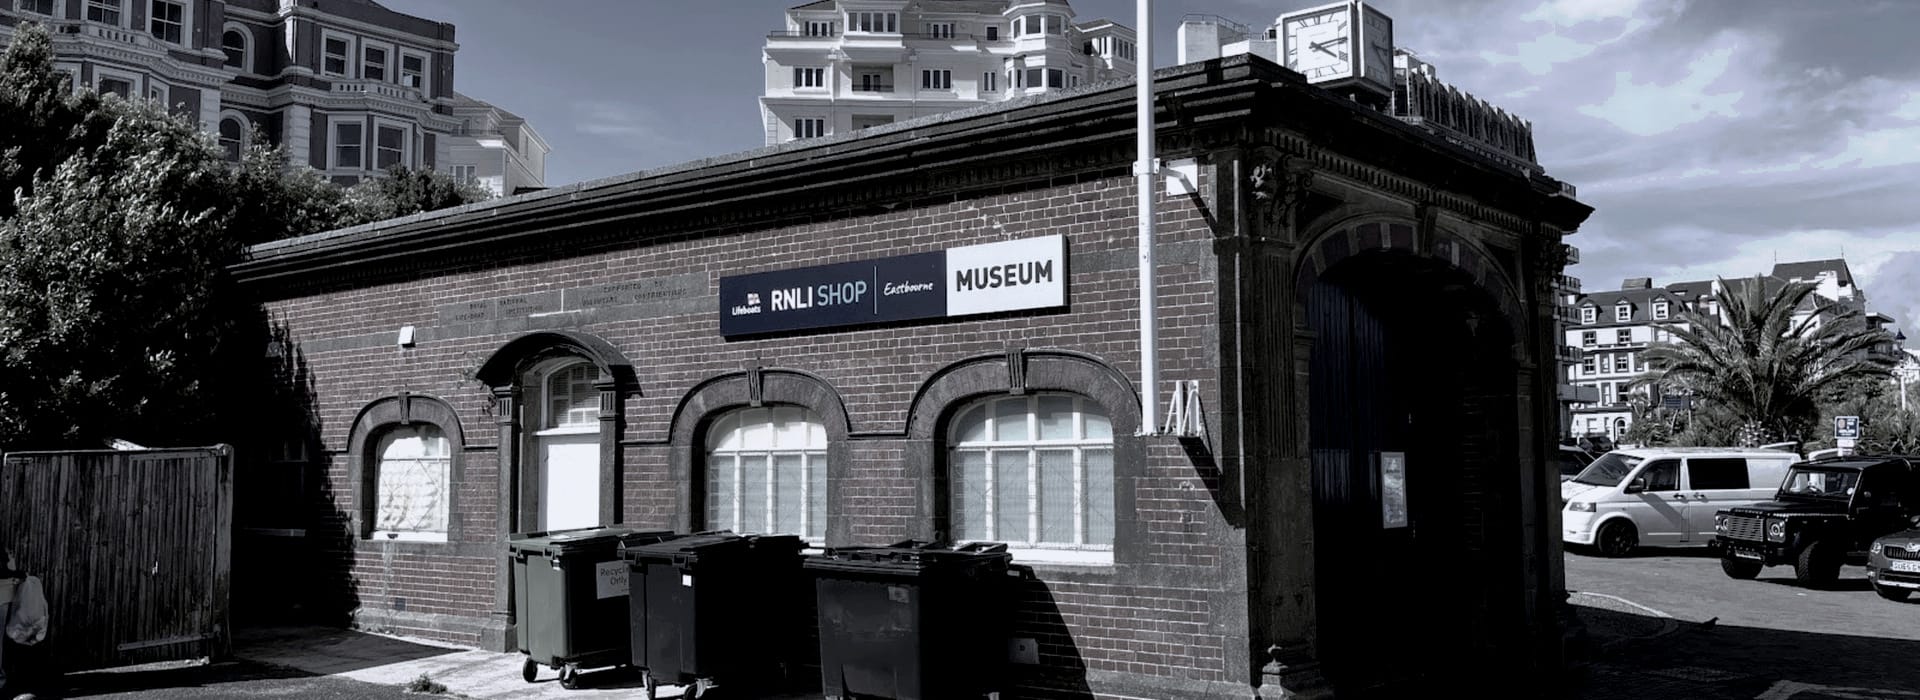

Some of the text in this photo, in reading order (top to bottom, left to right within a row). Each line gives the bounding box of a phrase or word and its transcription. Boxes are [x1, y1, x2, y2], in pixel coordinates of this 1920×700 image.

[956, 259, 1053, 292] MUSEUM
[771, 280, 867, 312] RNLI SHOP
[884, 280, 934, 296] Eastbourne
[731, 304, 761, 316] Lifeboats
[610, 572, 627, 586] Only
